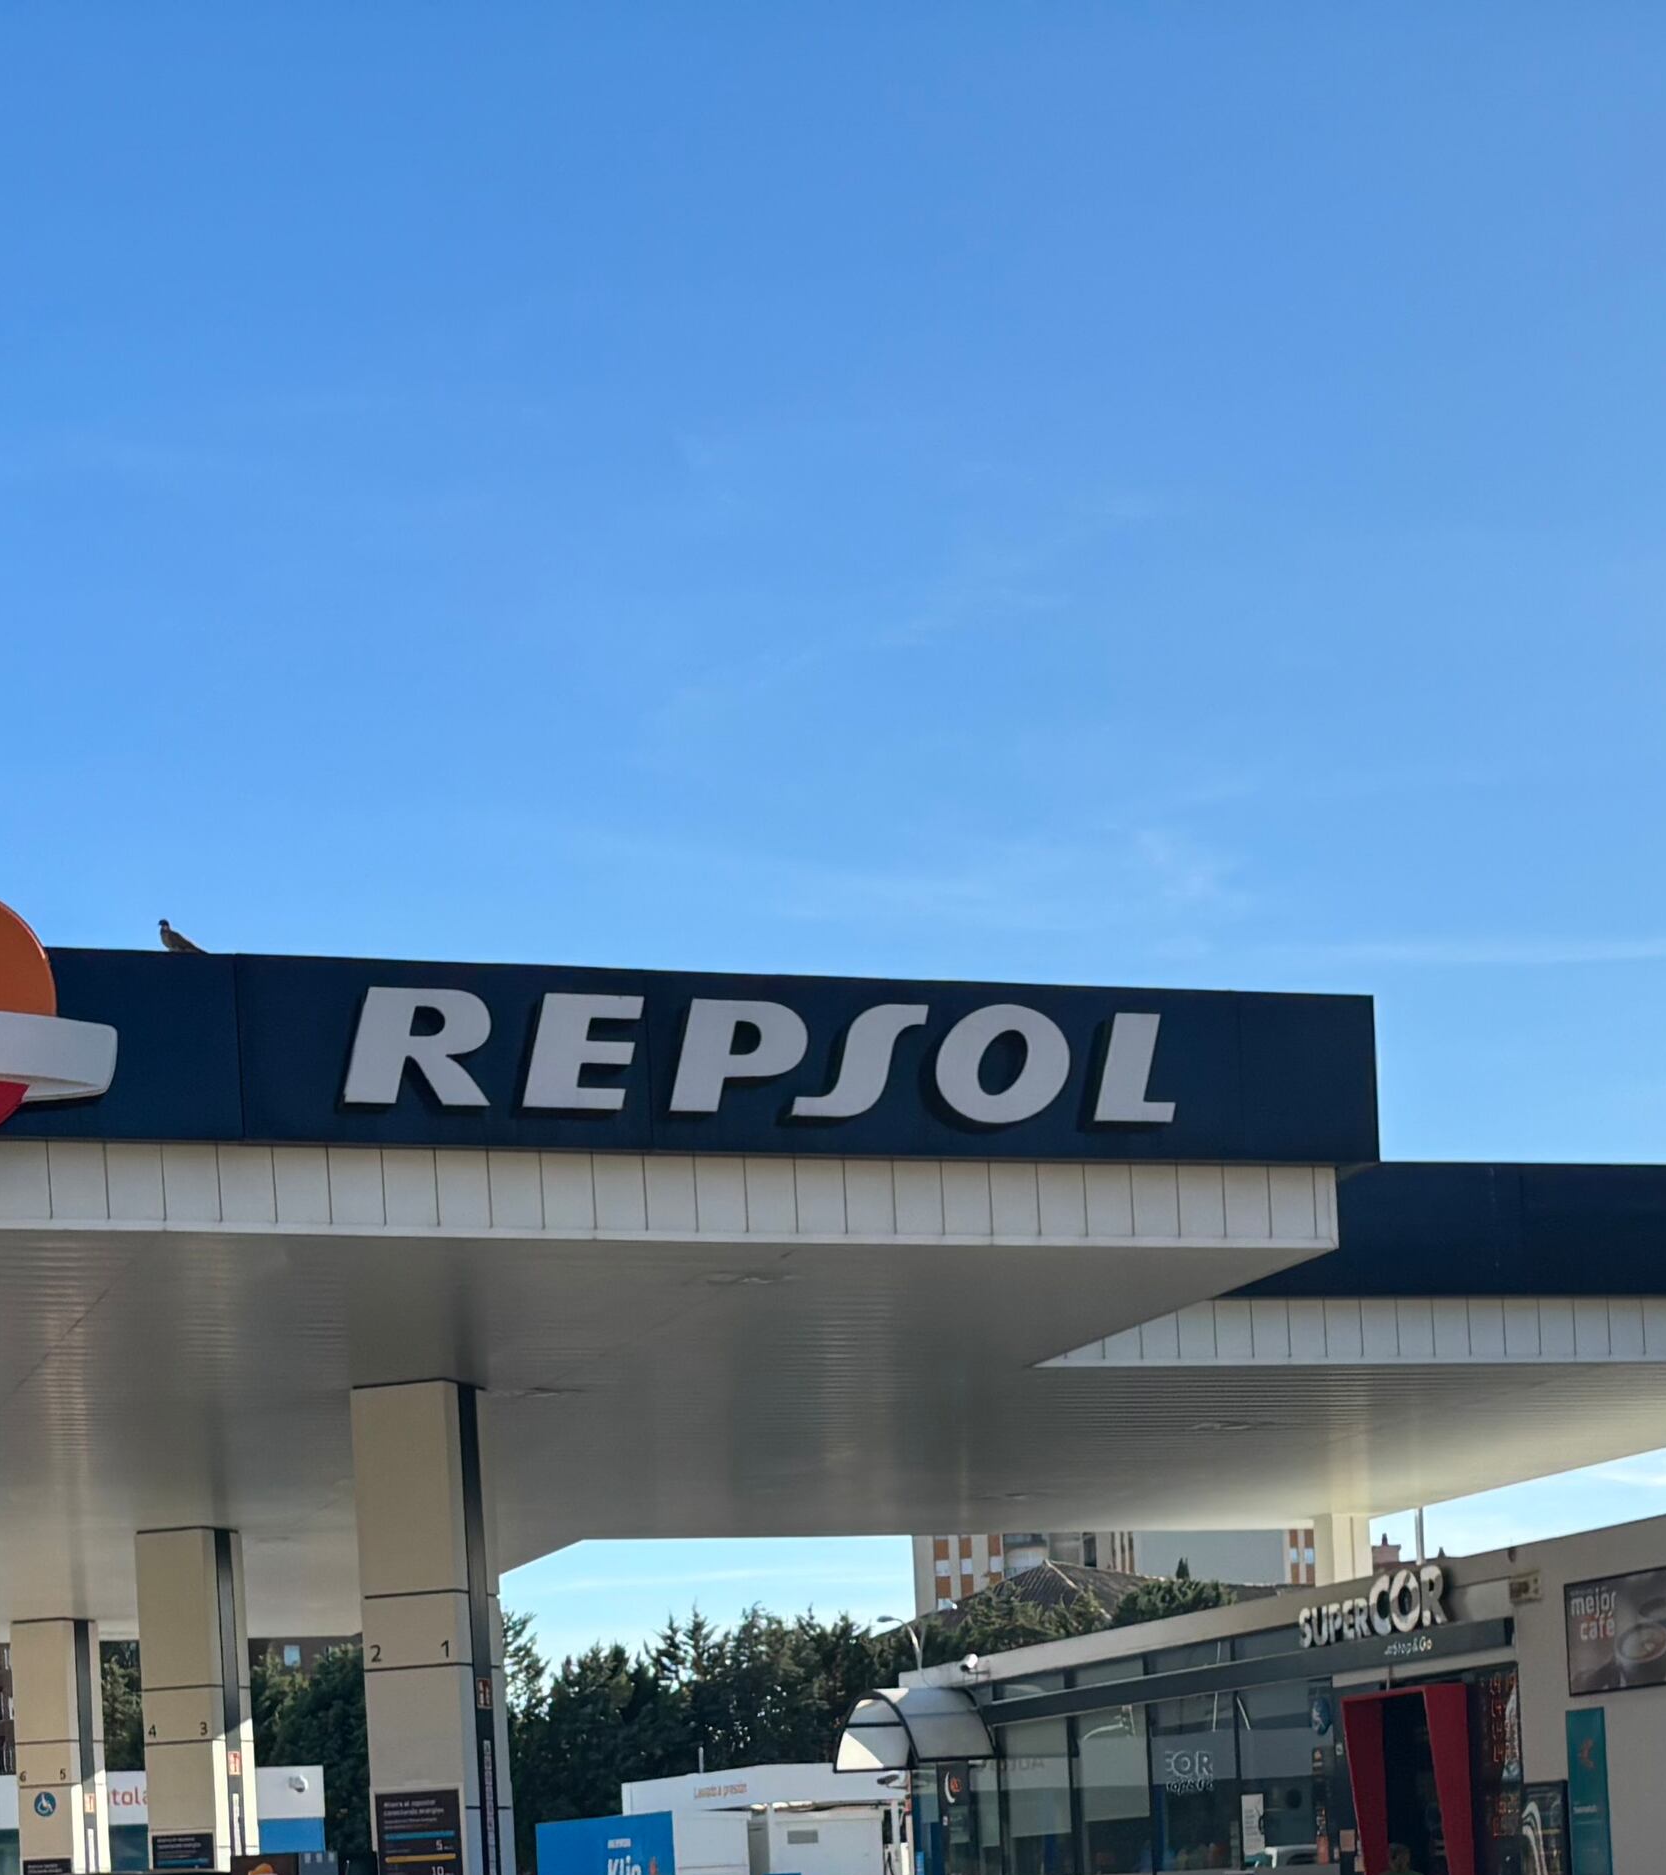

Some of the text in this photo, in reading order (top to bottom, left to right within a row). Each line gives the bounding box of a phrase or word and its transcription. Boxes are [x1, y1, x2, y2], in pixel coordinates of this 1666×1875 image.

[343, 986, 1176, 1124] REPSOL
[1299, 1565, 1448, 1648] SUPERCOR
[1570, 1586, 1616, 1619] mejor
[1580, 1610, 1615, 1641] café
[370, 1644, 383, 1663] 2
[441, 1640, 450, 1658] 1
[148, 1723, 157, 1738] 4
[199, 1721, 209, 1736] 3
[59, 1768, 67, 1780] 5
[436, 1839, 443, 1851] 5
